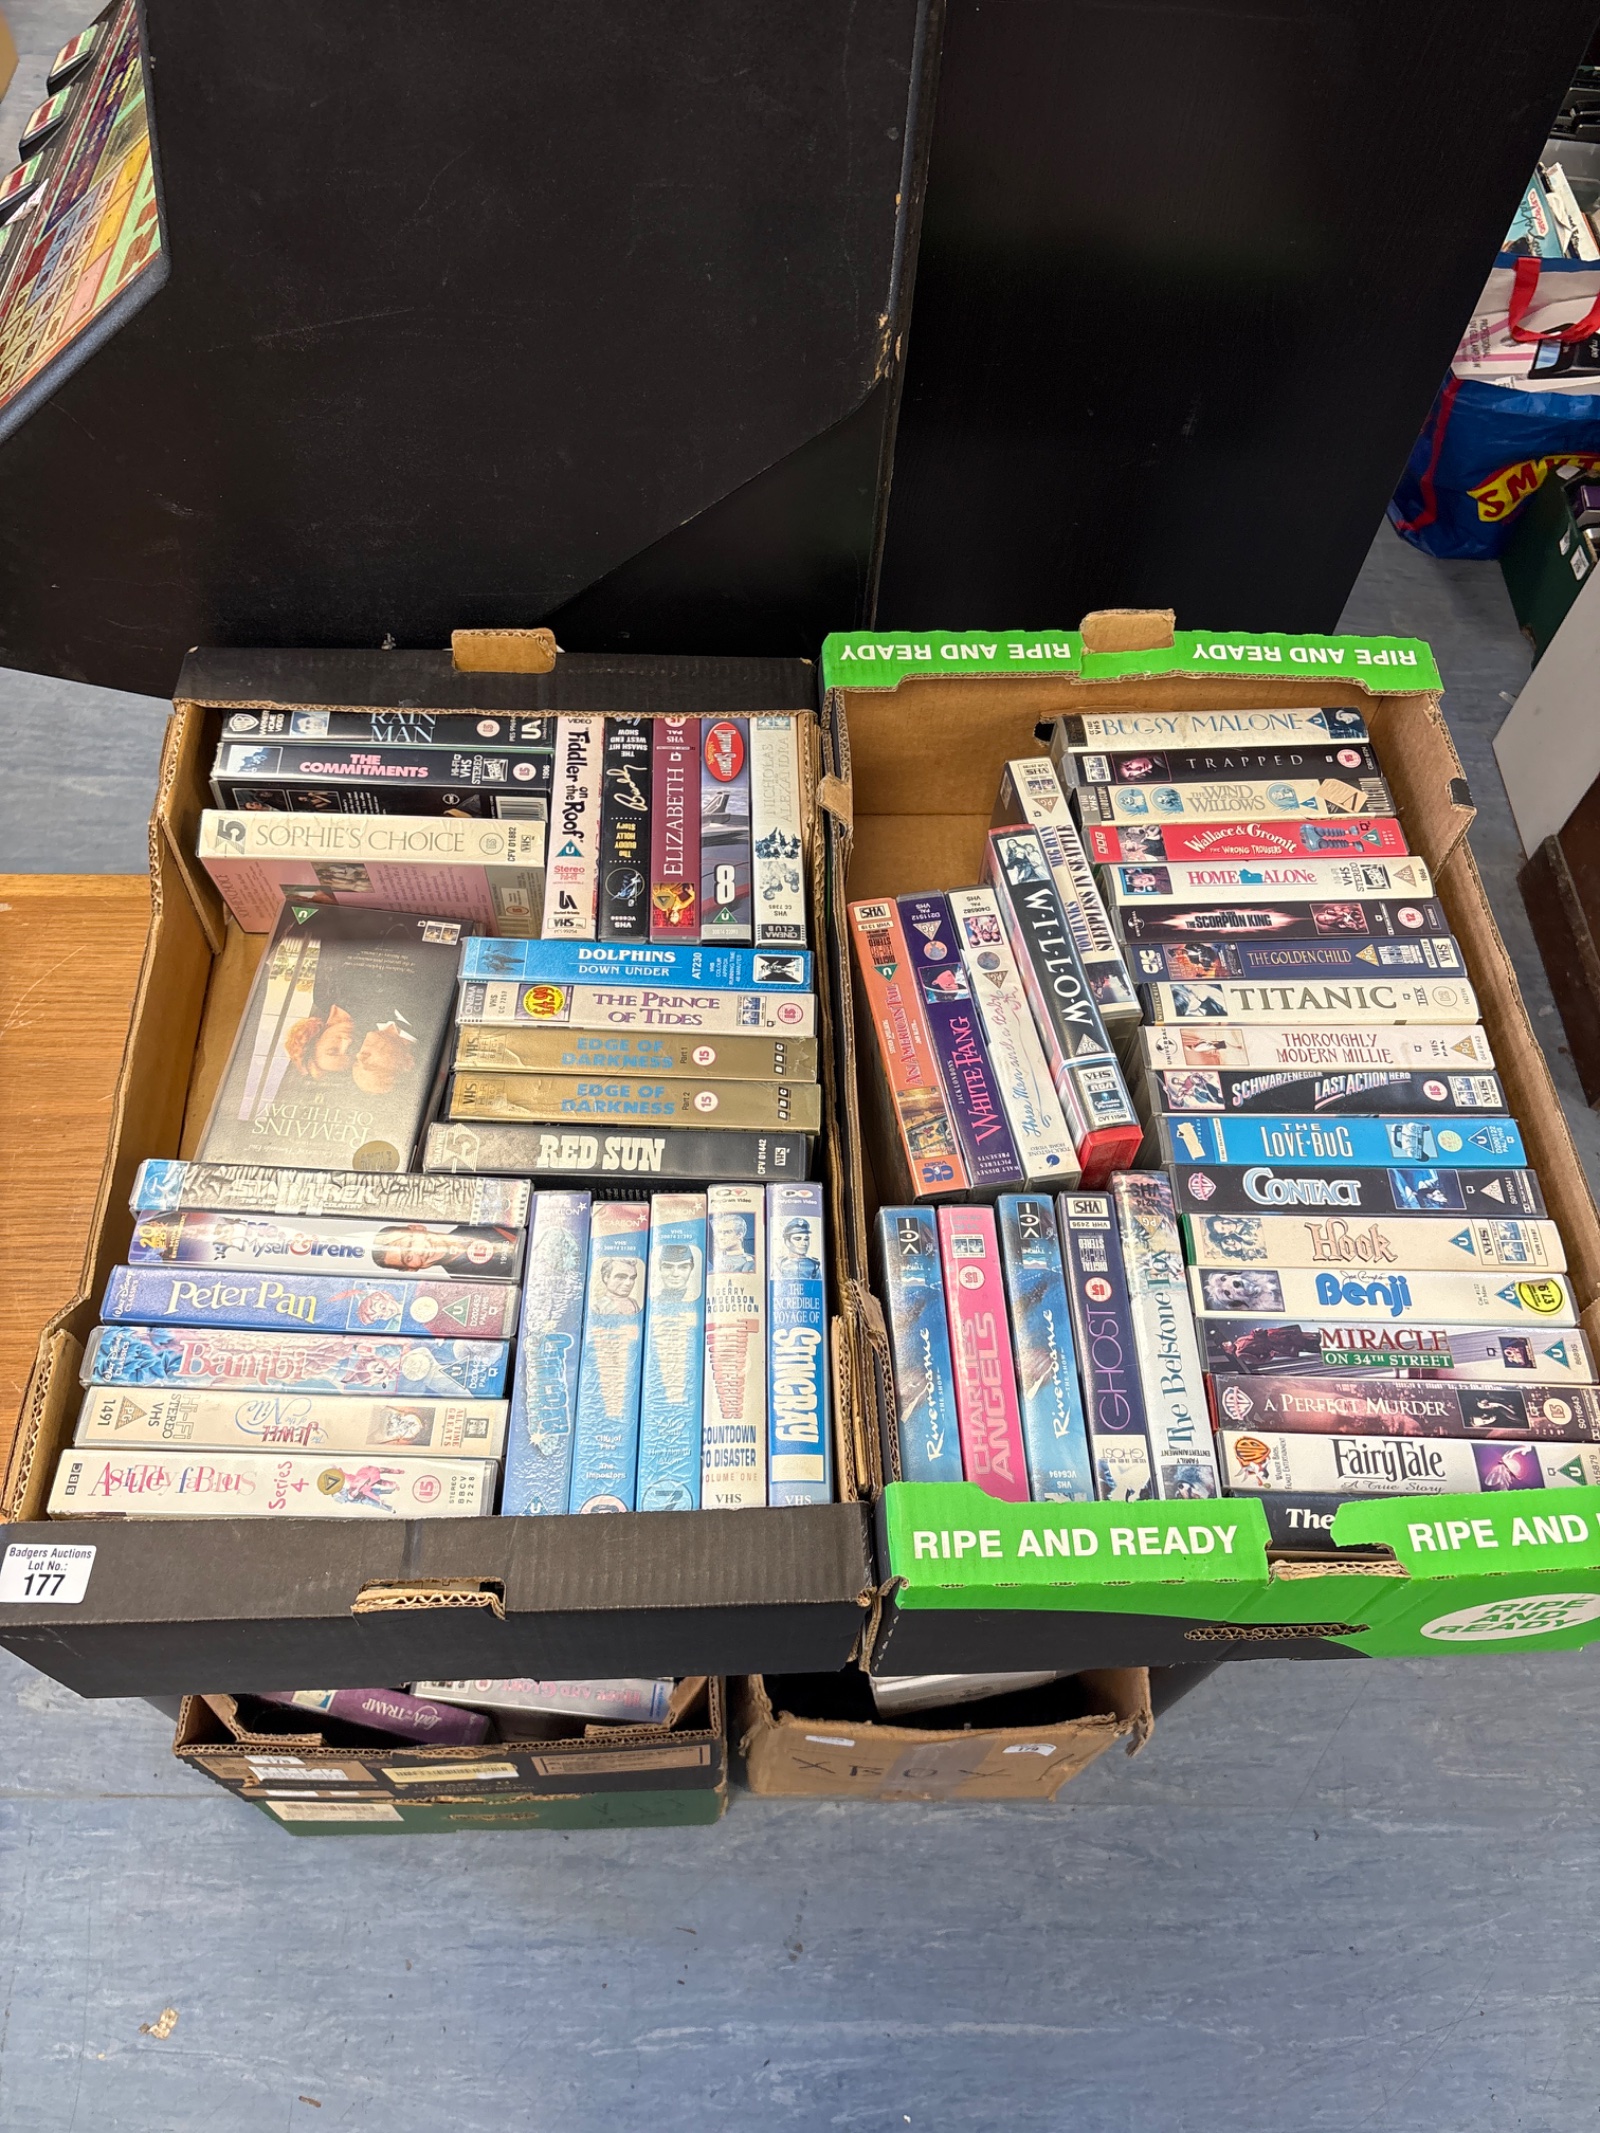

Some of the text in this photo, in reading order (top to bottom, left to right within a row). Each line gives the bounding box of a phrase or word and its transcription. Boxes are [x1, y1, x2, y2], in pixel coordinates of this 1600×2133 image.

[841, 642, 1070, 661] RIPE AND READY
[1193, 643, 1416, 667] RIPE AND READY
[371, 726, 434, 743] MAN
[1101, 713, 1302, 736] BUGSY MALONE
[350, 754, 381, 766] THE
[566, 730, 591, 783] Fiddler
[1186, 754, 1304, 769] TRAPPED
[300, 762, 428, 778] COMMITMENTS
[763, 743, 774, 816] NICHOLAS
[776, 736, 792, 822] ALEXANDRA
[562, 784, 585, 841] the Roof
[1186, 796, 1266, 813] WILLOWS
[664, 767, 684, 877] ELIZABETH
[255, 824, 465, 852] SOPHIE'S CHOICE
[1183, 823, 1298, 854] Wallace & Gromit
[714, 864, 736, 905] 8
[1187, 869, 1239, 885] HOME
[1056, 825, 1115, 953] SLEEPLESS IN SEATTLE
[1185, 913, 1273, 929] THE SCORPION KING
[765, 931, 798, 939] CINEMA
[578, 948, 676, 963] DOLPHINS
[691, 952, 703, 980] AT230
[1248, 948, 1352, 967] THE GOLDEN CHILD
[578, 965, 670, 977] DOWN UNDER
[592, 992, 721, 1010] THE PRINCE
[886, 982, 903, 1010] TAIL
[1231, 986, 1398, 1011] TITANIC
[607, 1008, 703, 1026] OF TIDES
[577, 1038, 665, 1052] EDGE OF
[892, 1003, 917, 1065] AMERICAN
[1282, 1033, 1378, 1049] THOROUGHLY
[561, 1053, 674, 1069] DARKNESS
[1277, 1048, 1395, 1066] MODERN MILLIE
[905, 1062, 923, 1087] AN
[952, 1016, 1002, 1146] WHITE FANG
[1084, 1070, 1111, 1080] VHS
[1314, 1071, 1412, 1101] LAST ACTION HERO
[463, 1082, 477, 1105] VHS
[577, 1084, 665, 1100] EDGE OF
[1231, 1071, 1324, 1108] SCHWARZENEGGER
[257, 1102, 374, 1126] OF THE DAY
[561, 1099, 676, 1115] DARKNESS
[252, 1117, 370, 1150] REMAINS
[1281, 1123, 1324, 1131] THE
[536, 1134, 666, 1172] RED SUN
[1028, 1147, 1071, 1157] TOUCHSTONE
[1260, 1126, 1354, 1157] LOVE BUG
[976, 1153, 1011, 1162] PRESENTS
[979, 1160, 1012, 1168] PICTURES
[1242, 1167, 1363, 1207] CONTACT
[1504, 1176, 1518, 1205] S015041
[1074, 1201, 1102, 1214] VHS
[1304, 1217, 1399, 1264] Hook
[1082, 1262, 1109, 1273] DIGITAL
[788, 1283, 804, 1296] THE
[1314, 1272, 1414, 1317] Benji
[163, 1280, 318, 1325] Peter Pan
[773, 1296, 820, 1310] INCREDIBLE
[773, 1310, 821, 1324] VOYAGE OF
[1153, 1292, 1189, 1399] Belstone
[1319, 1328, 1450, 1352] MIRACLE
[173, 1340, 309, 1386] Bambi
[1086, 1304, 1132, 1432] GHOST
[1324, 1352, 1452, 1368] ON 34TH STREET
[1026, 1308, 1070, 1439] Riverdance
[773, 1327, 822, 1444] STINGRAY
[901, 1327, 944, 1462] Riverdance
[974, 1311, 1015, 1485] ANGELS
[1264, 1395, 1450, 1417] A PERFECT MURDER
[96, 1399, 117, 1428] 1491
[148, 1401, 165, 1428] VHS
[162, 1393, 183, 1440] STEREO
[1571, 1396, 1587, 1430] S016643
[443, 1407, 457, 1447] GREATS
[703, 1425, 757, 1446] COUNTDOWN
[1166, 1403, 1198, 1452] The
[1100, 1447, 1145, 1459] GHOST
[1161, 1449, 1211, 1457] ENTERTAINMENT
[64, 1462, 83, 1495] BBC
[268, 1460, 293, 1510] Series
[290, 1477, 310, 1492] 4
[1048, 1470, 1077, 1479] VC6494
[466, 1475, 476, 1504] 7228
[714, 1493, 742, 1504] VHS
[1286, 1508, 1335, 1530] The
[914, 1525, 1237, 1559] RIPE AND READY
[1407, 1514, 1588, 1552] RIPE AND
[9, 1547, 92, 1559] Badgers Auctions
[24, 1573, 66, 1596] 177
[1487, 1599, 1590, 1613] RIPE
[1497, 1609, 1567, 1622] AND
[1431, 1618, 1579, 1635] READY
[362, 1699, 406, 1720] TRAMP
